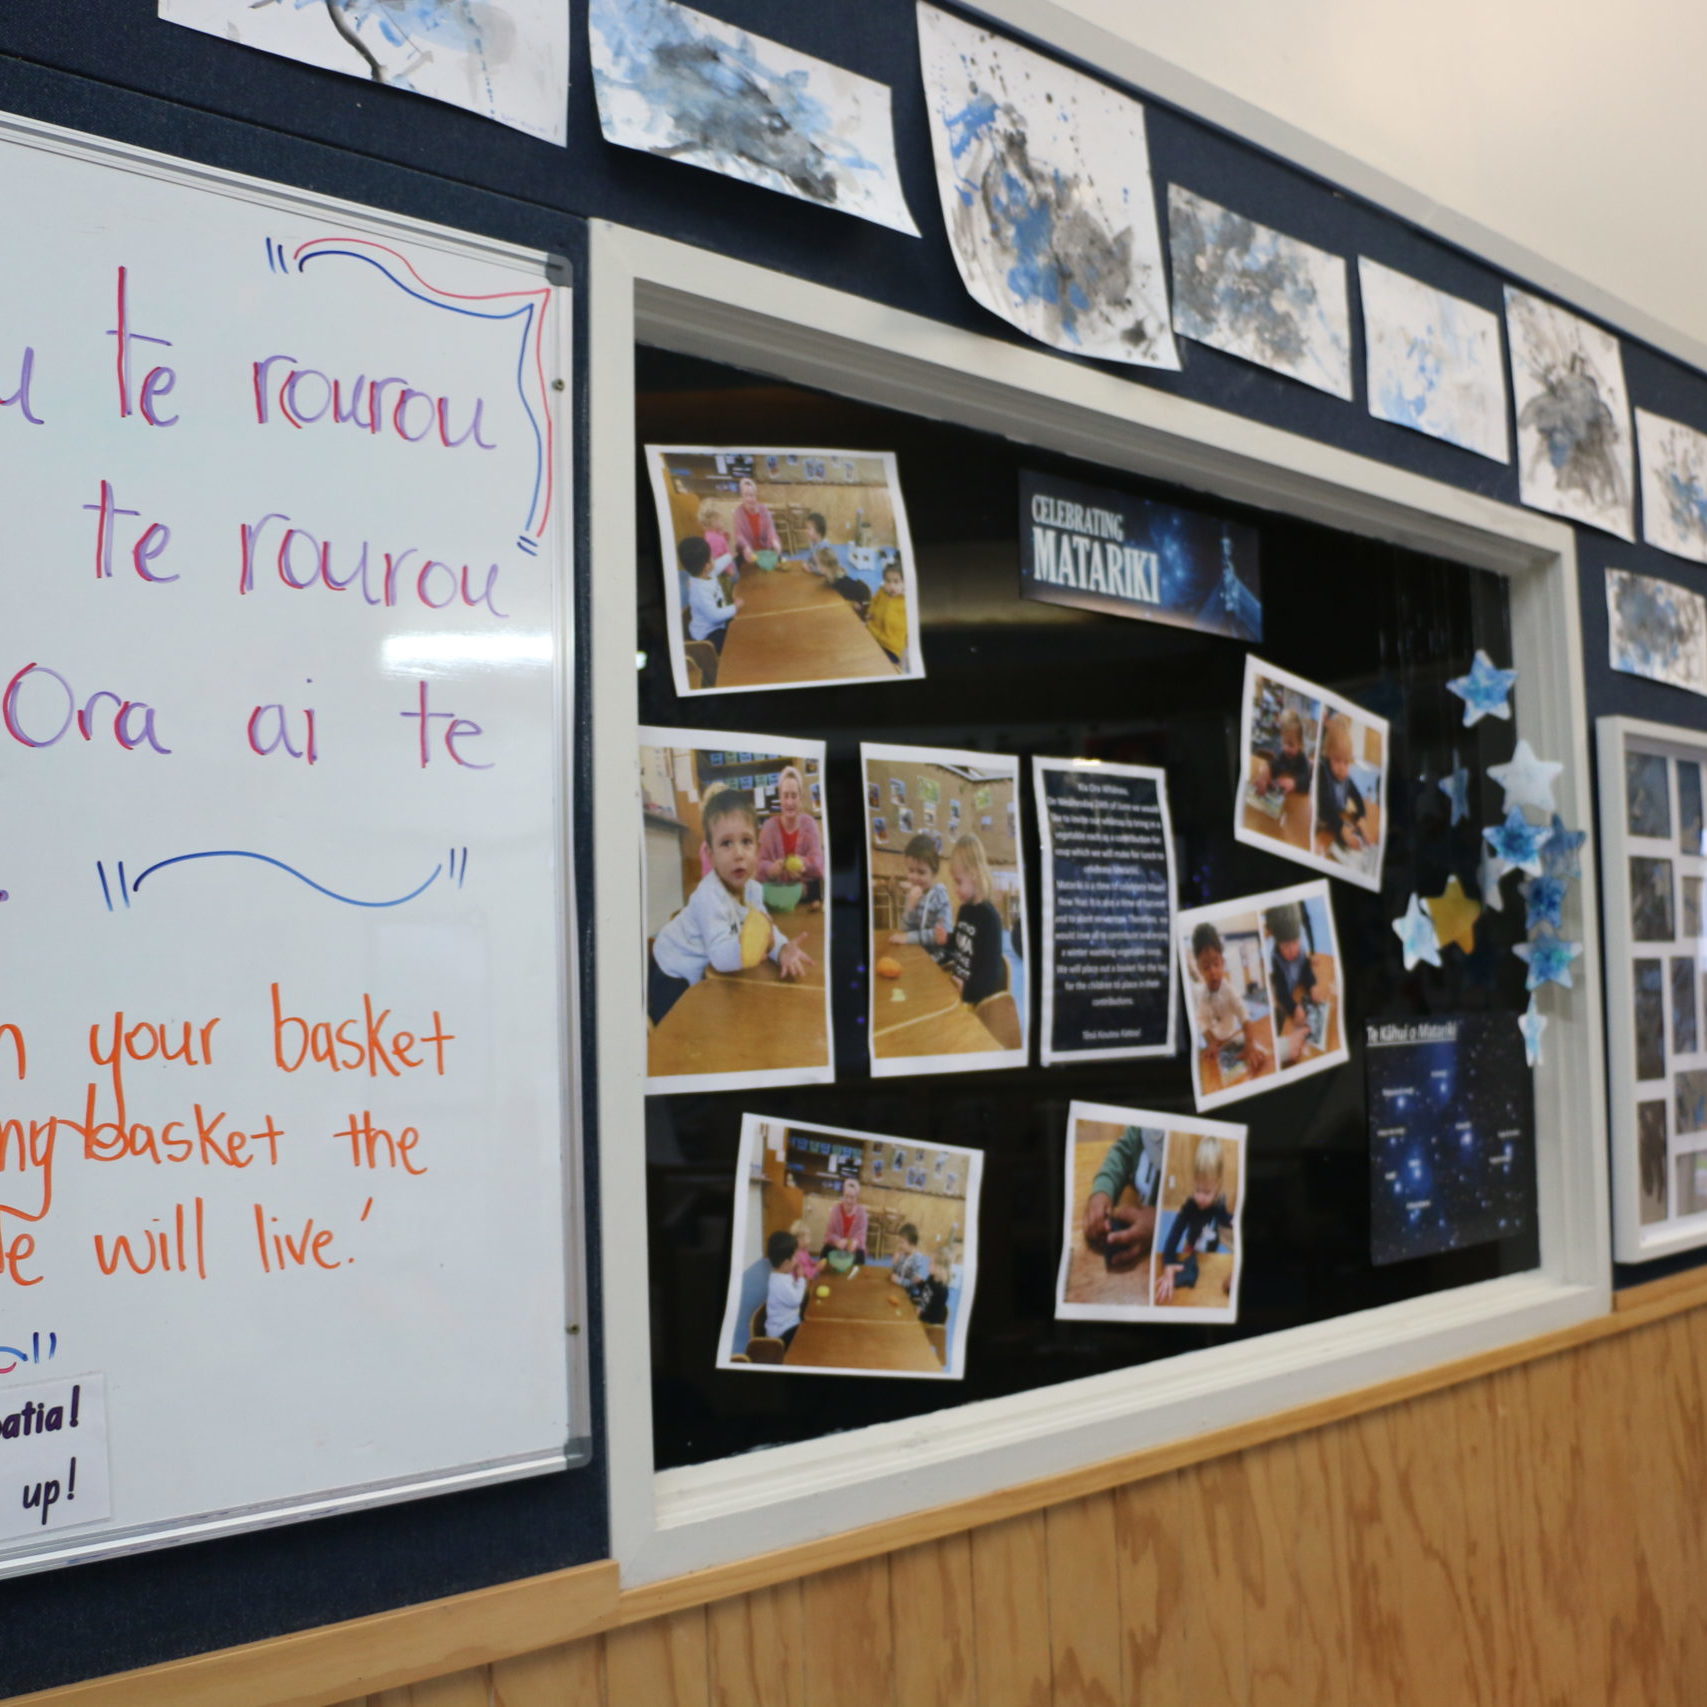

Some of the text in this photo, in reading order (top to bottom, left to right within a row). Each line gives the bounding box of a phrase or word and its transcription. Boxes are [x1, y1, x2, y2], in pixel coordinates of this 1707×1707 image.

[106, 266, 179, 427] te
[252, 354, 497, 450] rourou
[83, 480, 509, 618] te rourou
[1031, 494, 1124, 542] CELEBRATING
[1032, 526, 1161, 604] MATARIKI
[248, 678, 318, 765] ai
[400, 680, 495, 769] te
[90, 1012, 220, 1149] your
[271, 983, 455, 1077] basket
[84, 1083, 285, 1168] basket
[333, 1111, 428, 1176] the
[94, 1197, 206, 1280] will
[0, 1385, 80, 1439] atia!
[23, 1456, 76, 1525] up!
